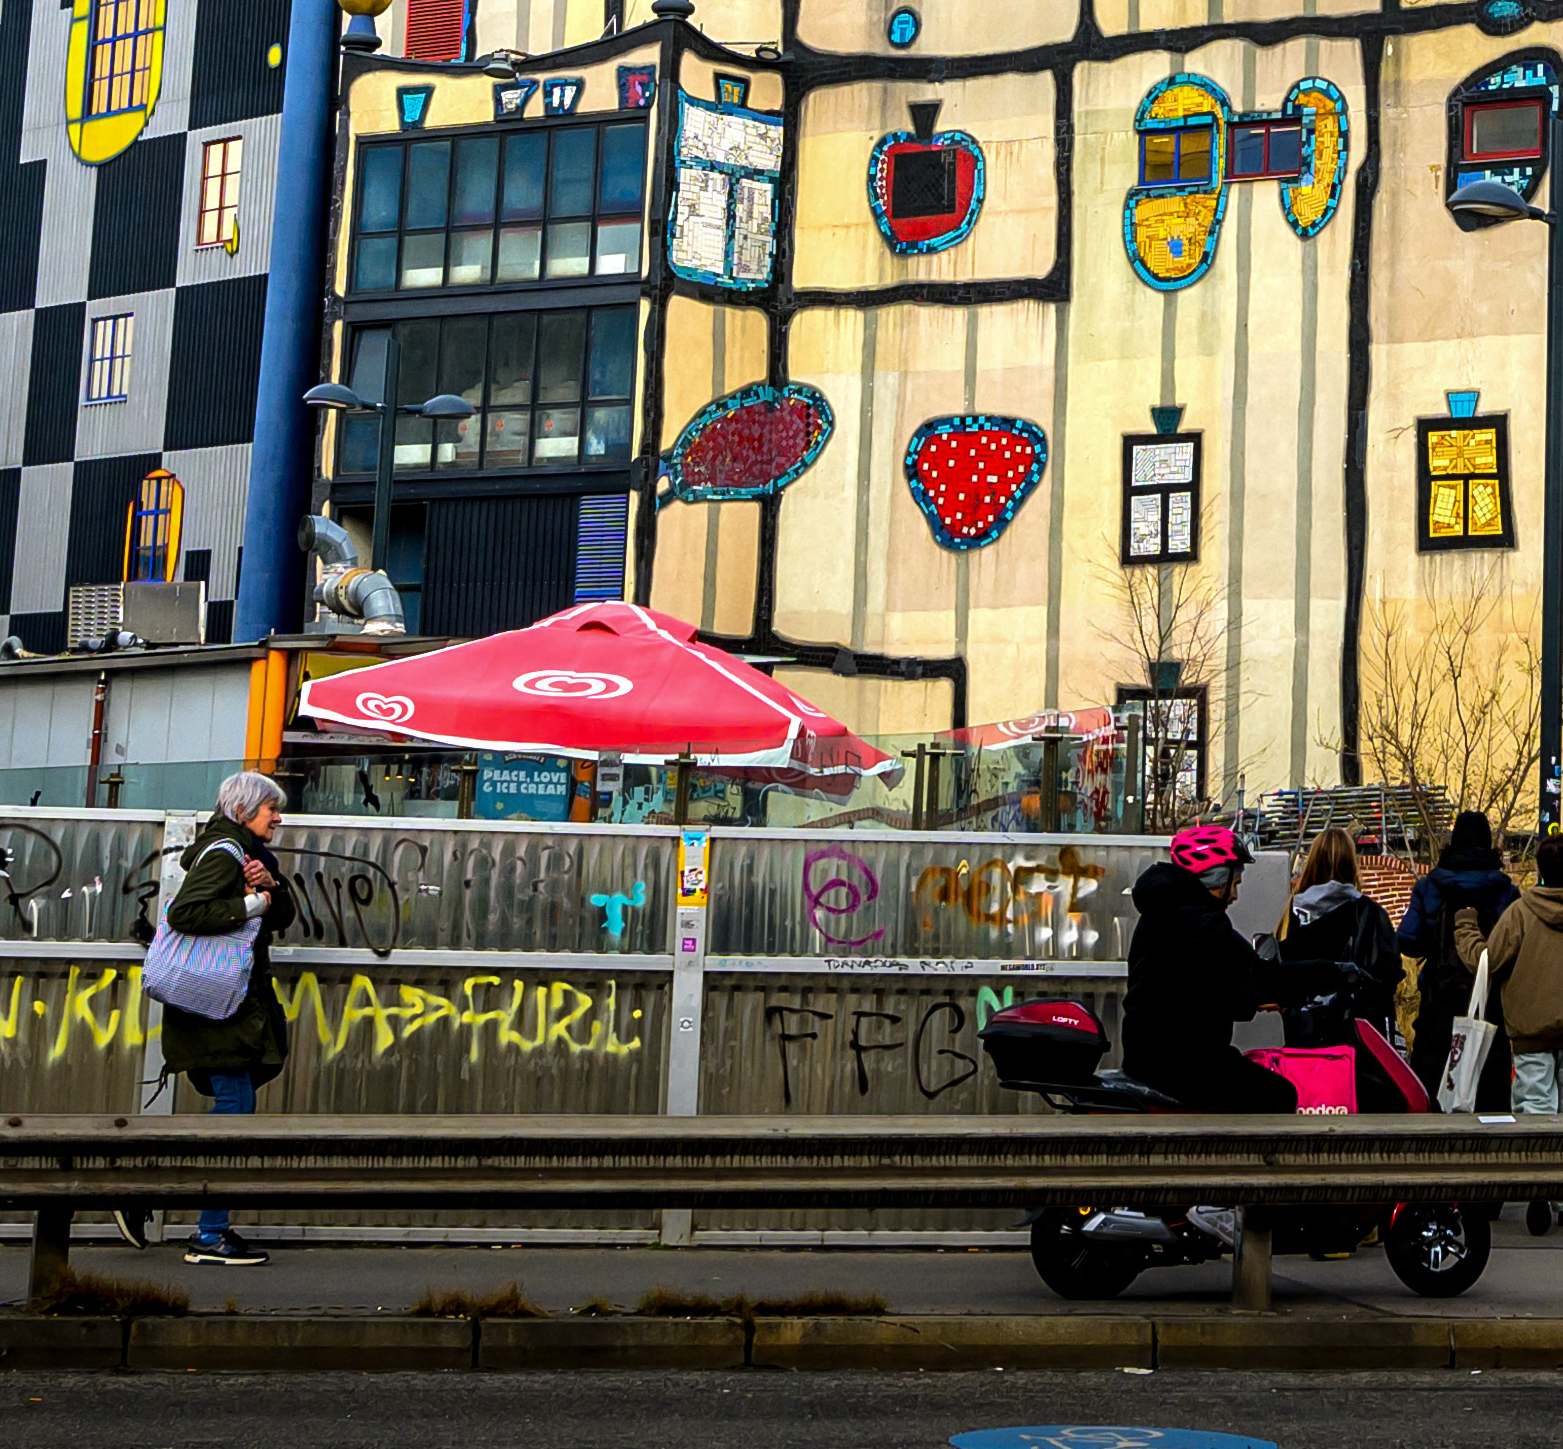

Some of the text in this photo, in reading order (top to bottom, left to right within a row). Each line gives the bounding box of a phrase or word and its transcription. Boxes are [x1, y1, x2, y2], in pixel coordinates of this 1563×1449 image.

[483, 769, 567, 784] PEACE, LOVE
[483, 782, 567, 795] & ICE CREAM
[1052, 1015, 1080, 1026] LOFTY
